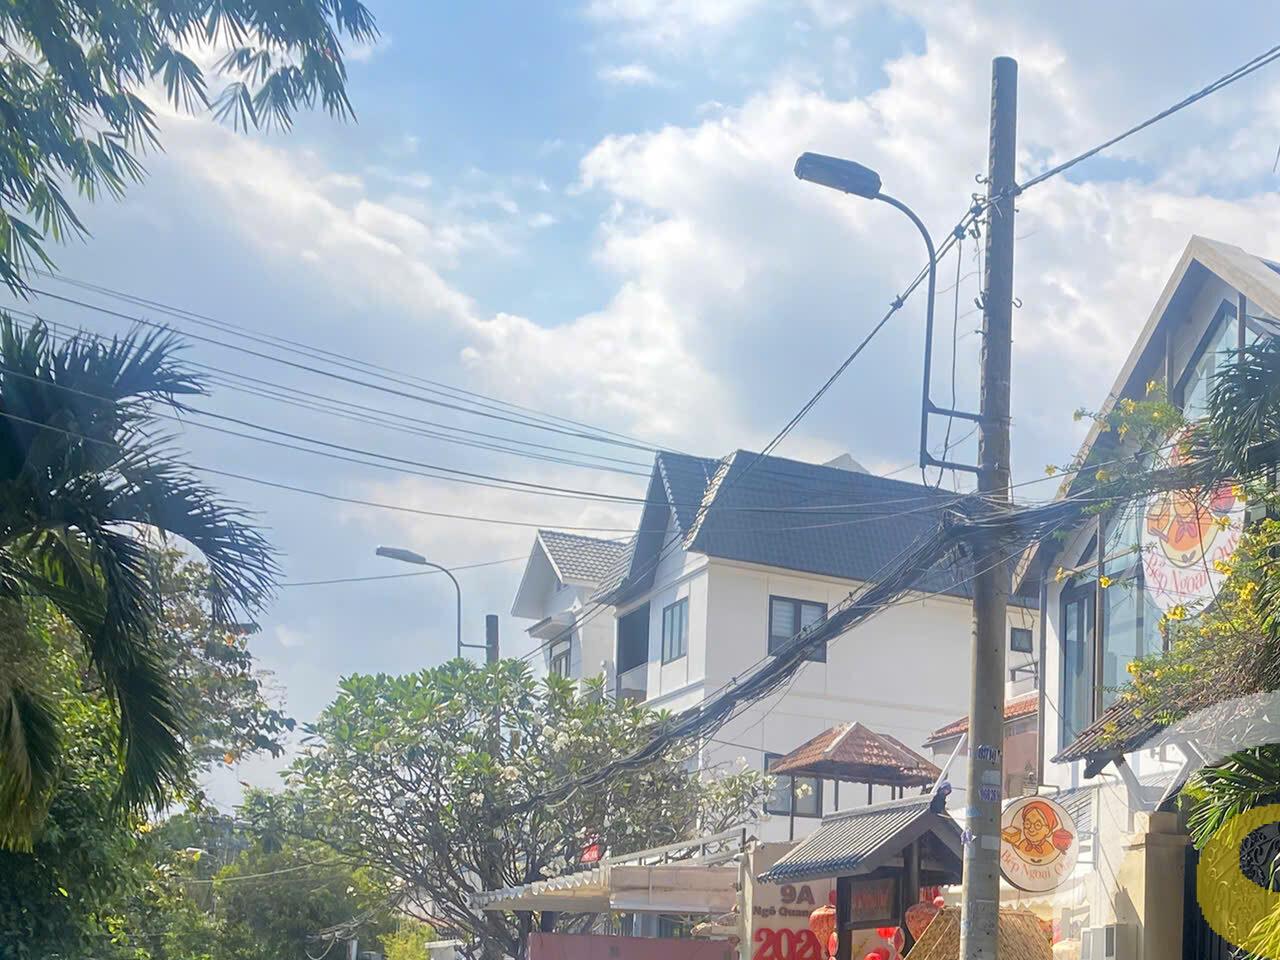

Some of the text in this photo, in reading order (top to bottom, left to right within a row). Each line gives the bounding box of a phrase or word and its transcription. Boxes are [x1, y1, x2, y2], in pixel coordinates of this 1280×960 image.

[780, 884, 816, 905] 9A
[753, 905, 810, 918] Ngô Quan
